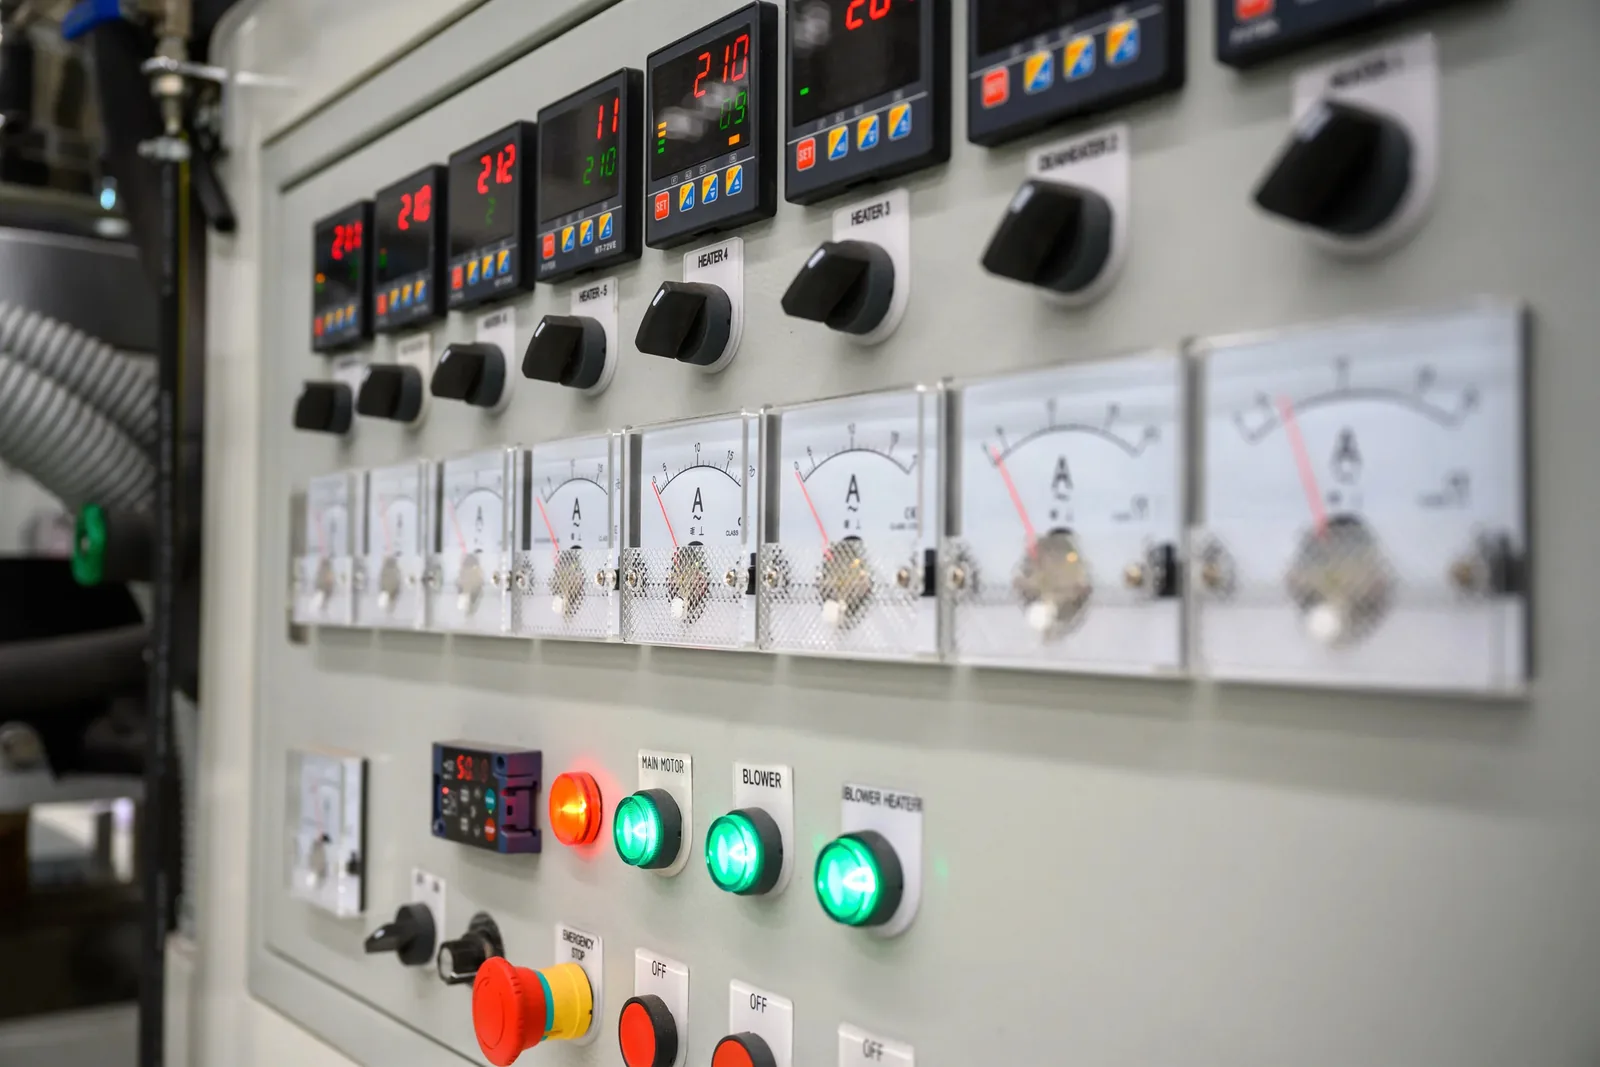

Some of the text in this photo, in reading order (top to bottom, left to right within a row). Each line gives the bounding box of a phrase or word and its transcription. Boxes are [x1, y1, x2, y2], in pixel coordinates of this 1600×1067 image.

[694, 34, 749, 98] 210
[720, 91, 747, 130] 09
[799, 147, 813, 162] SET
[477, 143, 516, 194] 212
[583, 146, 616, 185] 210
[656, 199, 668, 212] SET
[851, 203, 884, 226] HEATER
[698, 247, 728, 268] HEATER 4
[579, 287, 600, 302] HEATER
[694, 442, 701, 453] 10
[727, 450, 734, 461] 15
[662, 463, 667, 472] 5
[652, 475, 657, 484] 0
[846, 474, 860, 503] A
[572, 497, 581, 520] A
[692, 487, 704, 513] A
[641, 756, 685, 774] MAIN MOTOR
[742, 768, 782, 789] BLOWER
[843, 786, 881, 806] BLOWER
[562, 929, 594, 951] EMERGENCY
[571, 947, 586, 961] STOP
[651, 960, 667, 979] OFF
[749, 993, 768, 1014] OFF
[862, 1038, 884, 1062] OFF
